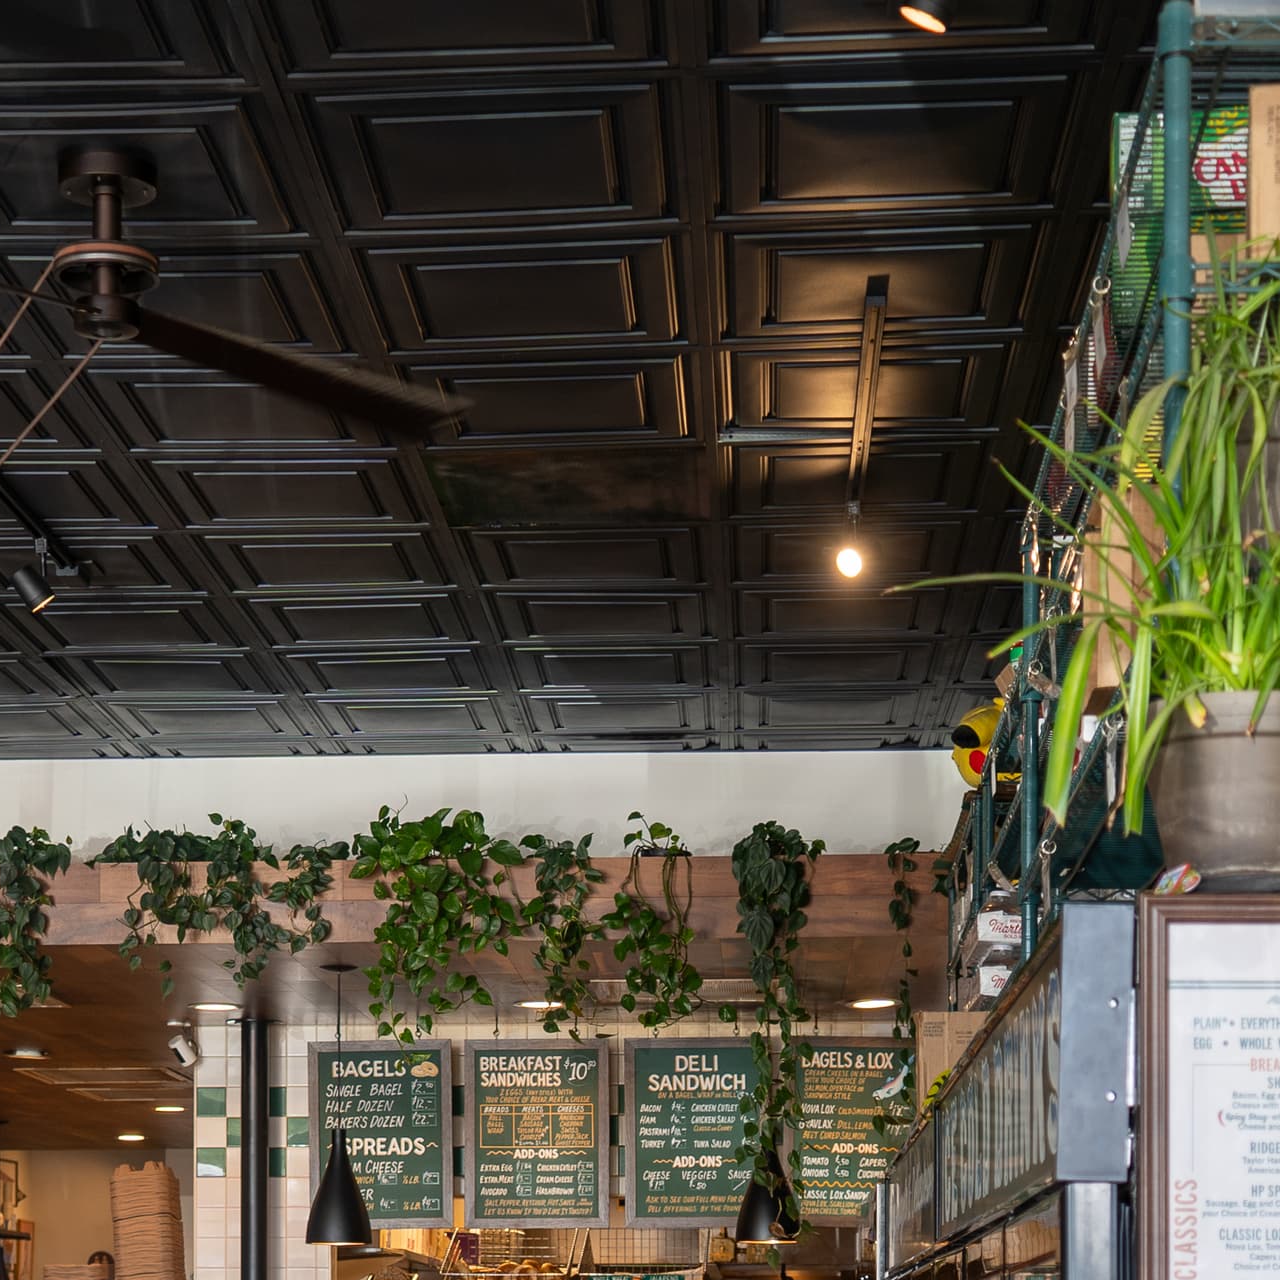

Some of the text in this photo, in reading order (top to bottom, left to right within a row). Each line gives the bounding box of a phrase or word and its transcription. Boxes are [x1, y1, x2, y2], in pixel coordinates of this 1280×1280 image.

[1240, 1038, 1272, 1050] WHOLE
[480, 1056, 562, 1071] BREAKFAST
[675, 1055, 719, 1072] DELI
[855, 1055, 865, 1068] &
[867, 1052, 894, 1069] LOX
[332, 1060, 406, 1078] BAGELS
[481, 1072, 561, 1087] SANDWICHES
[648, 1074, 746, 1092] SANDWICH
[326, 1083, 403, 1097] SINGLE BAGEL
[325, 1100, 393, 1113] HALF DOZEN
[640, 1104, 662, 1113] BACON
[691, 1104, 717, 1112] CHICKEN
[325, 1115, 405, 1129] BAKER'S DOZEN
[640, 1115, 736, 1124] HAM CHICKEN SALAD
[639, 1128, 670, 1136] PASTRAMI
[345, 1137, 426, 1156] SPREADS
[641, 1140, 666, 1148] TURKEY
[711, 1140, 731, 1148] SALAD
[831, 1144, 880, 1154] ADD-ONS
[513, 1149, 559, 1159] ADD-ONS
[365, 1160, 404, 1174] CHEESE
[480, 1164, 513, 1172] EXTRA EGG
[672, 1156, 722, 1168] ADD-ONS
[803, 1157, 887, 1167] TOMATO CAPERS
[643, 1170, 752, 1180] CHEESE VEGGIES SAUCE
[802, 1167, 829, 1177] ONIONS
[1174, 1179, 1198, 1280] CLASSICS
[1220, 1229, 1262, 1241] CLASSIC
